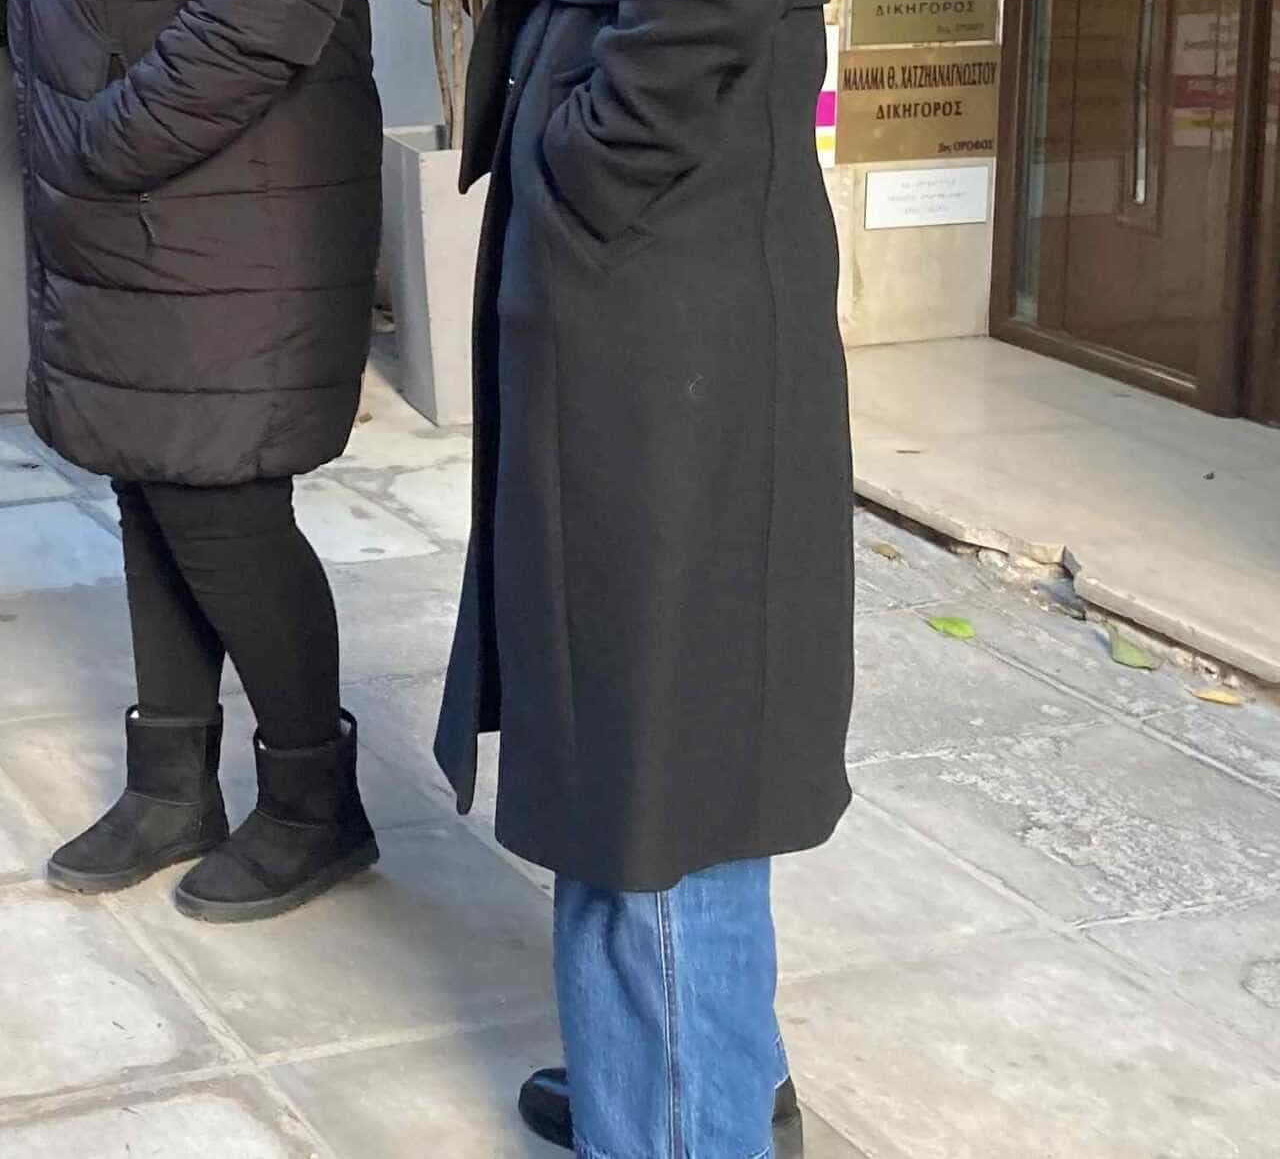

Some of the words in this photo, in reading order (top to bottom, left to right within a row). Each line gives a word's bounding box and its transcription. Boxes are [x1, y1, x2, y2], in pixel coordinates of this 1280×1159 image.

[875, 0, 976, 16] ΔΙΚΗΓΟΡΟΣ
[843, 64, 885, 91] ΜΑΛΑΜΑ
[900, 60, 998, 89] ΧΑΤΖΗΑΝΑΓΝΩΣΤΟΥ
[875, 101, 964, 120] ΔΙΚΗΓΟΡΟΣ
